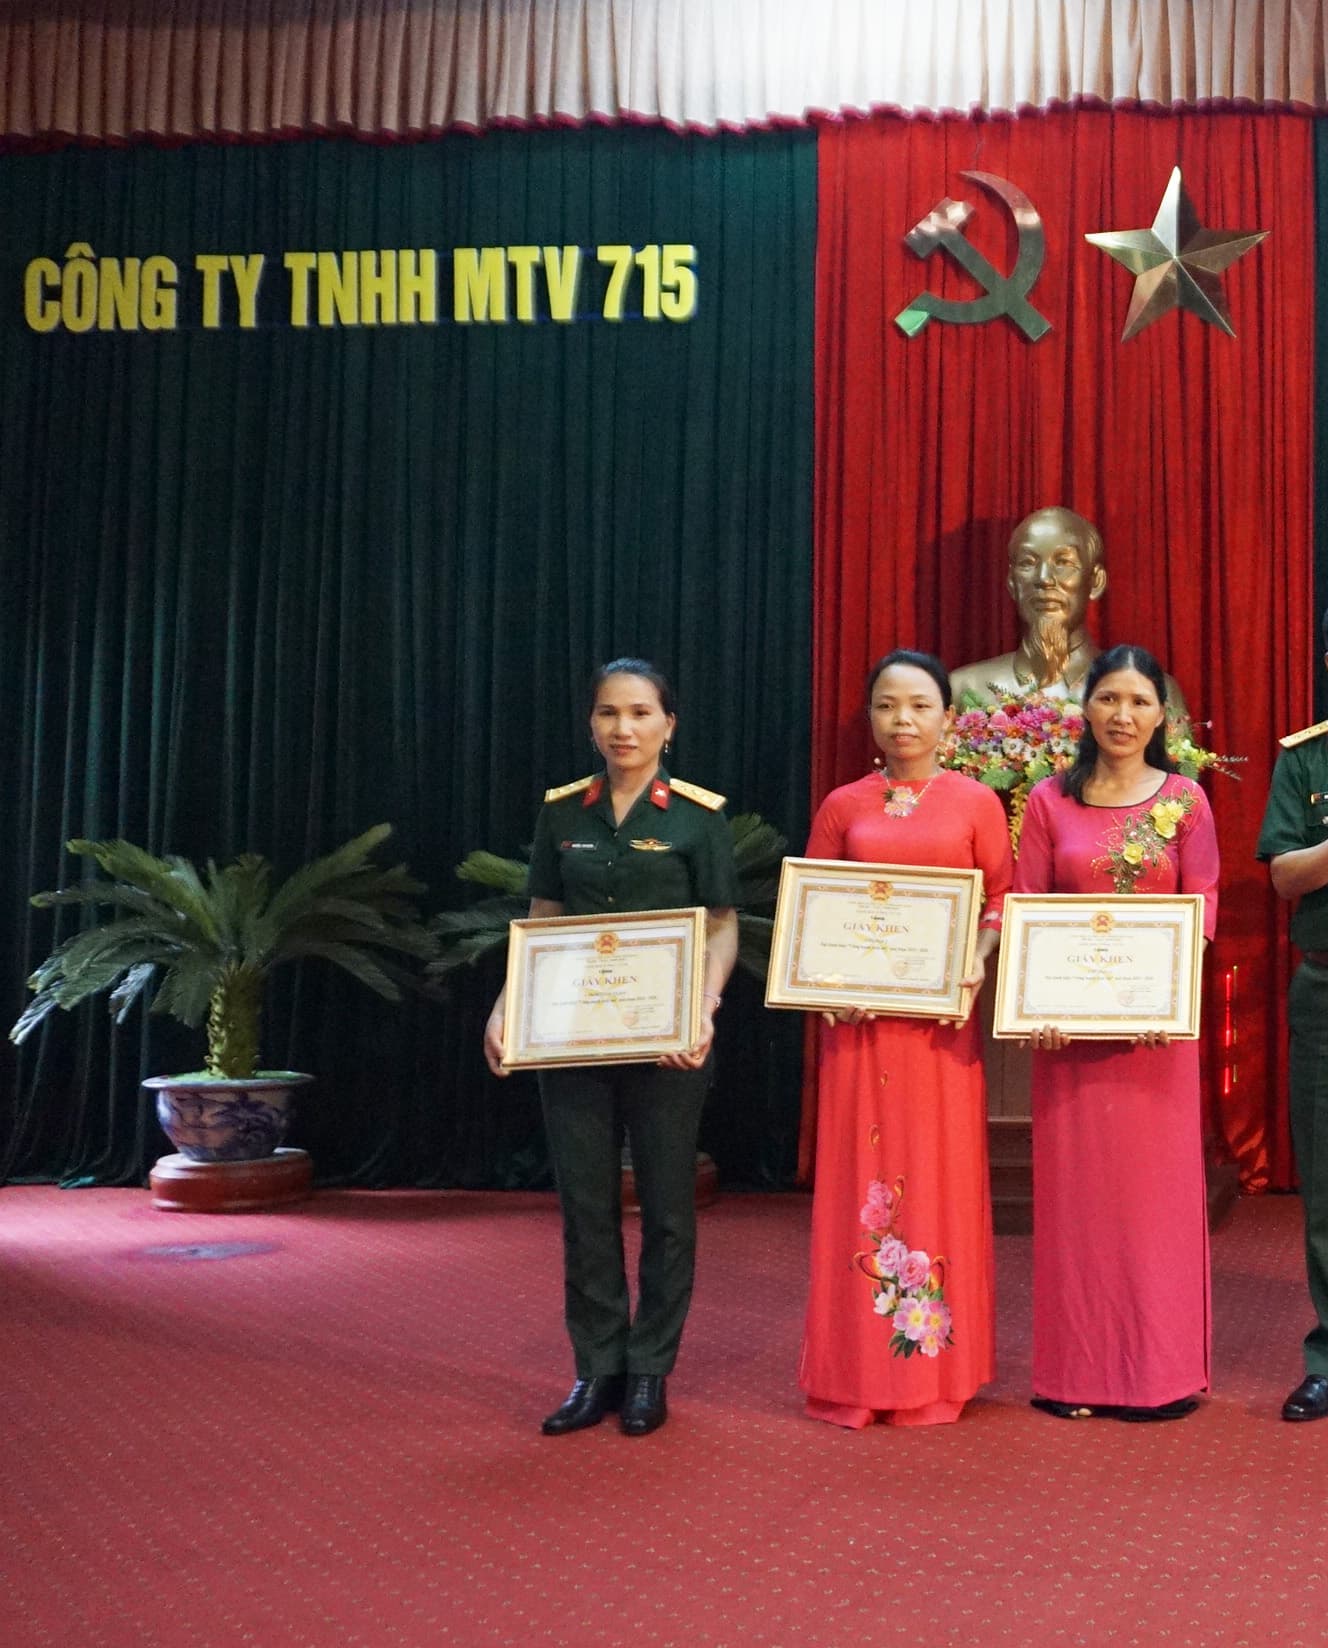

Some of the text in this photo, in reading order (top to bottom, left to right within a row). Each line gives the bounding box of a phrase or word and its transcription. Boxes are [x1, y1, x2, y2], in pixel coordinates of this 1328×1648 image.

[25, 243, 695, 332] CÔNG TY TNHH MTV 715
